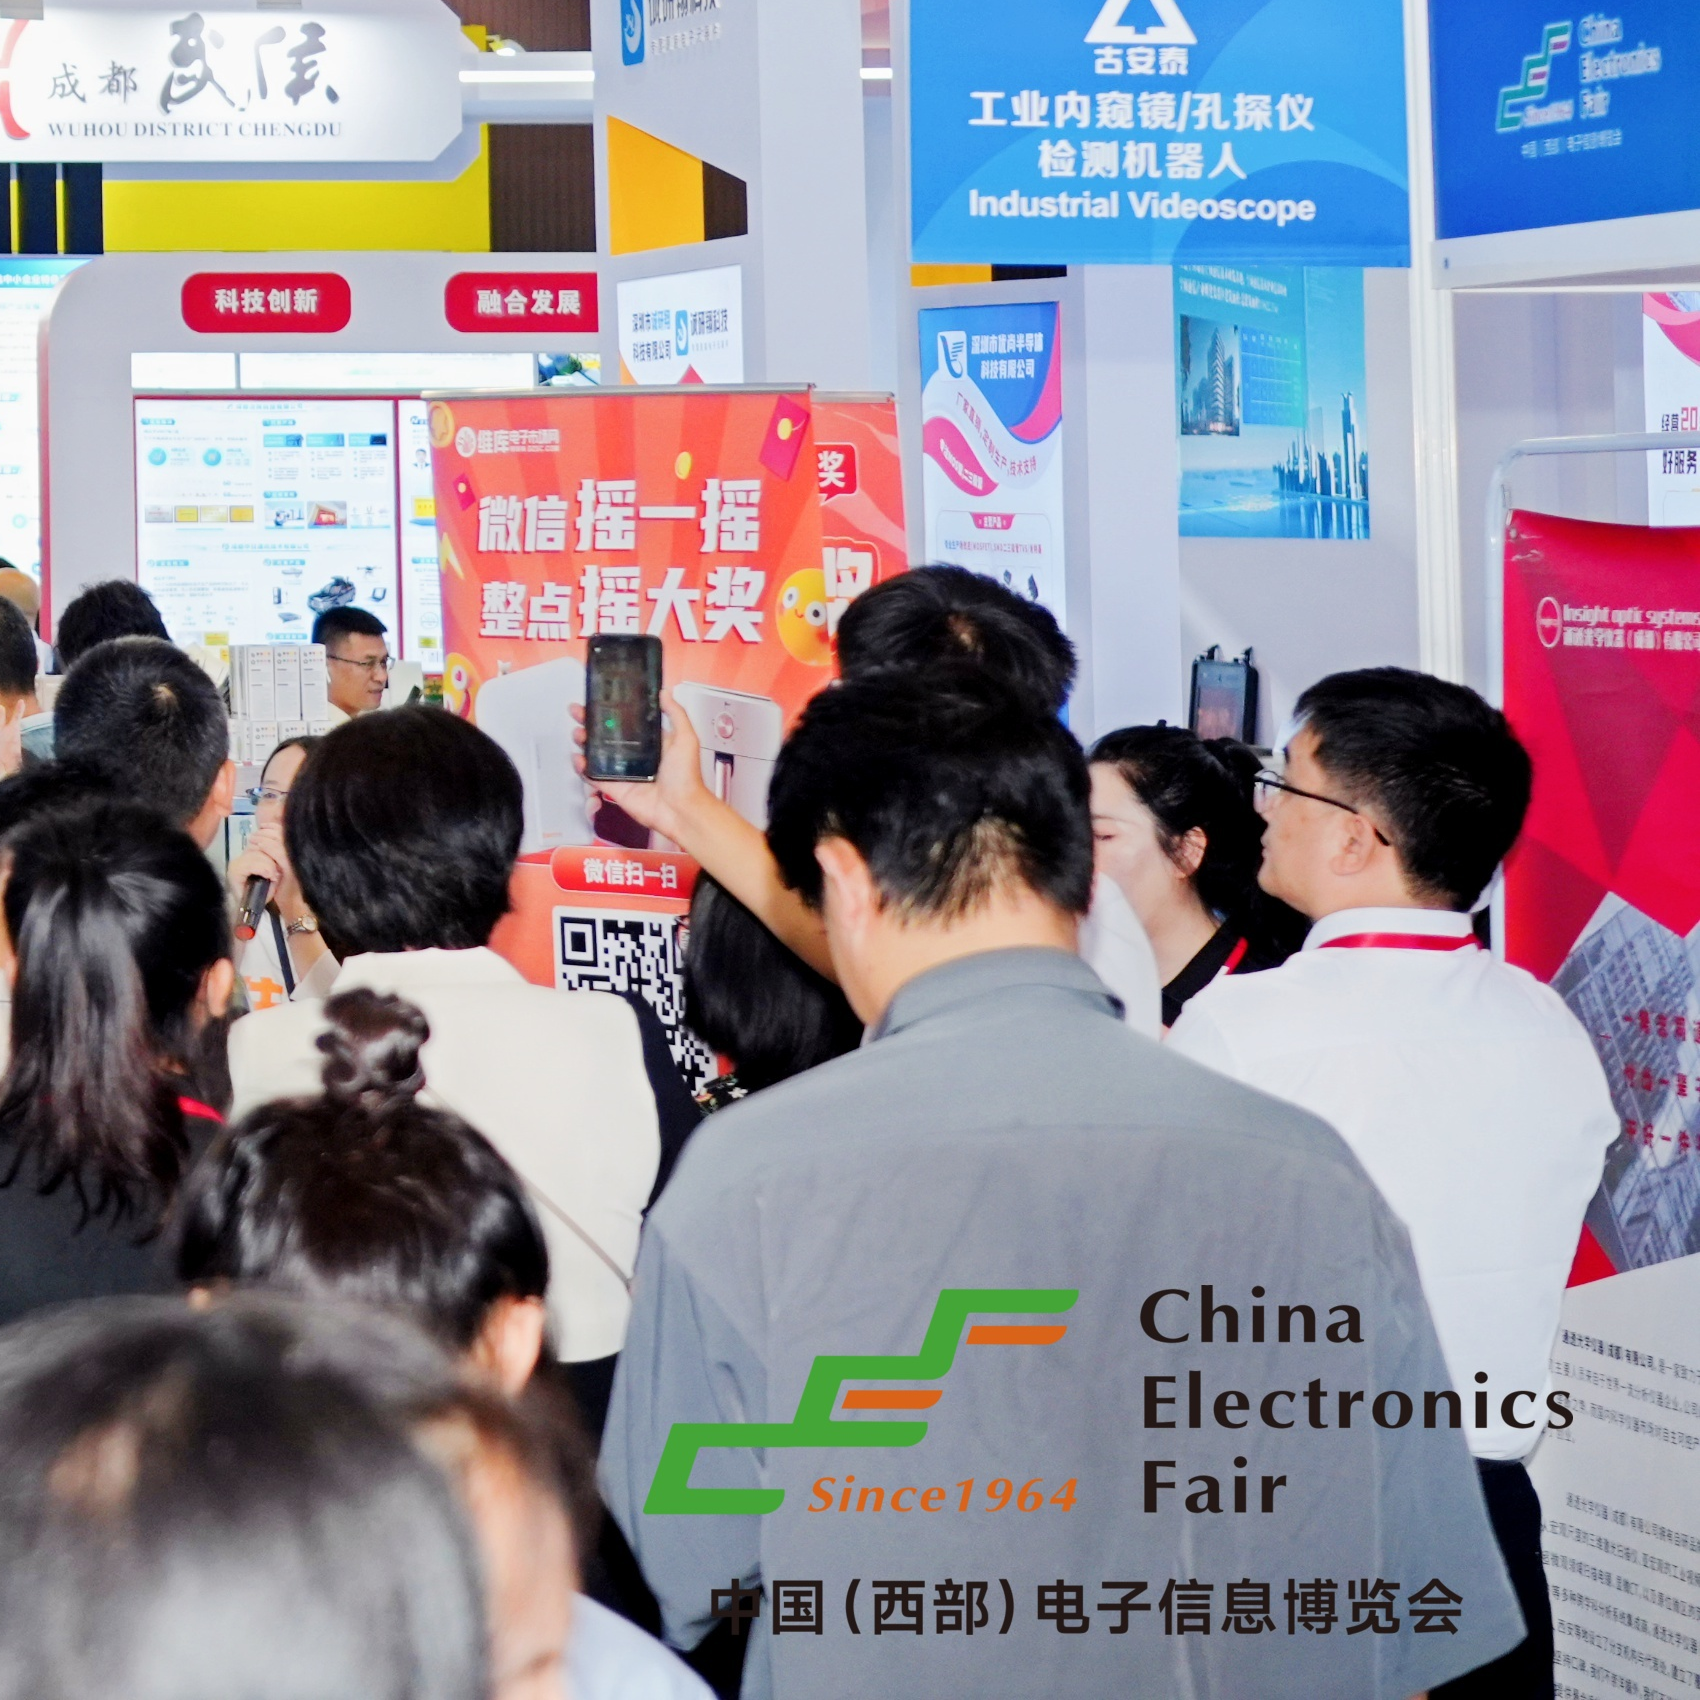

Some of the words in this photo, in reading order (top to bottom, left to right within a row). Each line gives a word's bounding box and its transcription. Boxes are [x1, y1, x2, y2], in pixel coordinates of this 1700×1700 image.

[1093, 46, 1189, 77] 古安泰
[49, 61, 139, 104] 成都
[48, 121, 128, 138] WUHOU
[133, 121, 234, 138] DISTRICT
[239, 121, 343, 138] CHENGDU
[967, 89, 1316, 134] 工业内窥镜/孔探仪
[1038, 139, 1248, 180] 检测机器人
[969, 188, 1119, 219] Industrial
[1128, 188, 1317, 228] Videoscope
[214, 288, 319, 315] 科技创新
[476, 288, 582, 315] 融合发展
[477, 478, 761, 554] 微信摇一摇
[479, 565, 766, 644] 整点摇大奖
[583, 858, 678, 889] 微信扫一扫
